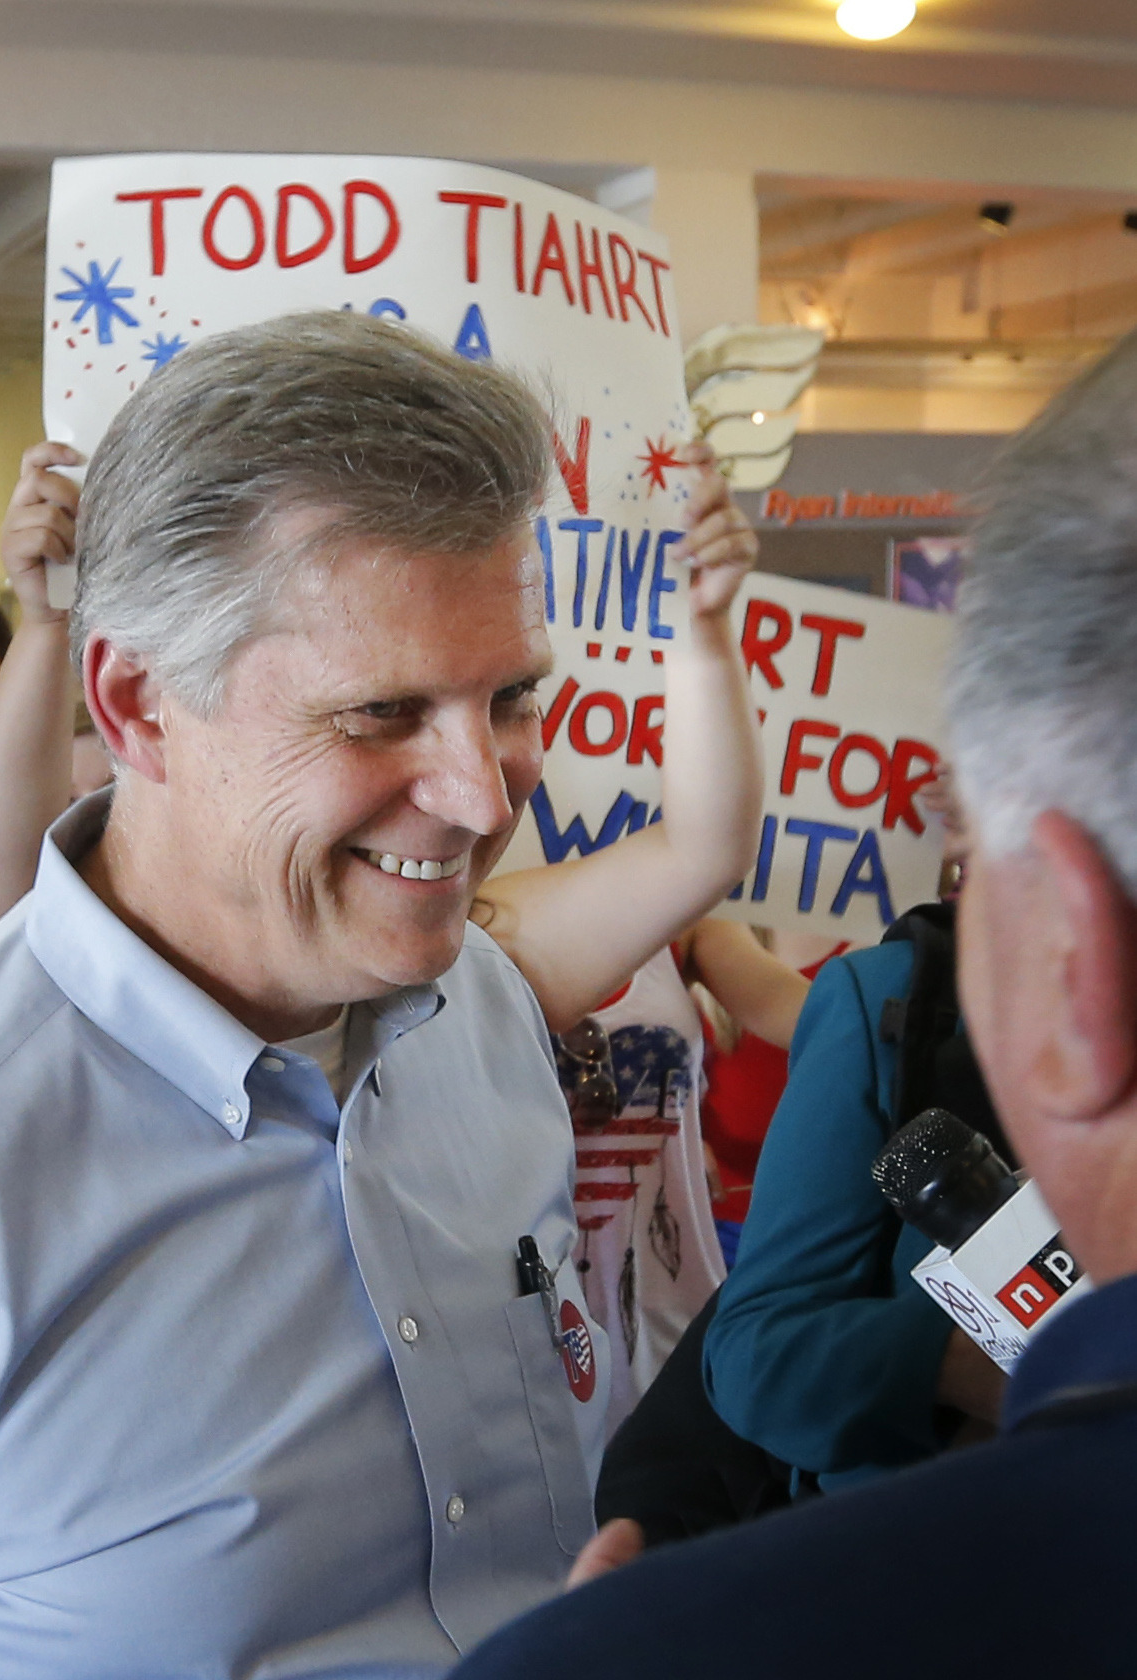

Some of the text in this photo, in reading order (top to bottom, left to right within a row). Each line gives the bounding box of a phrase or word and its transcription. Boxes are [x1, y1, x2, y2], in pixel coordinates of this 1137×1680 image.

[116, 180, 671, 337] TODD TIAHRT
[780, 718, 940, 837] FOR
